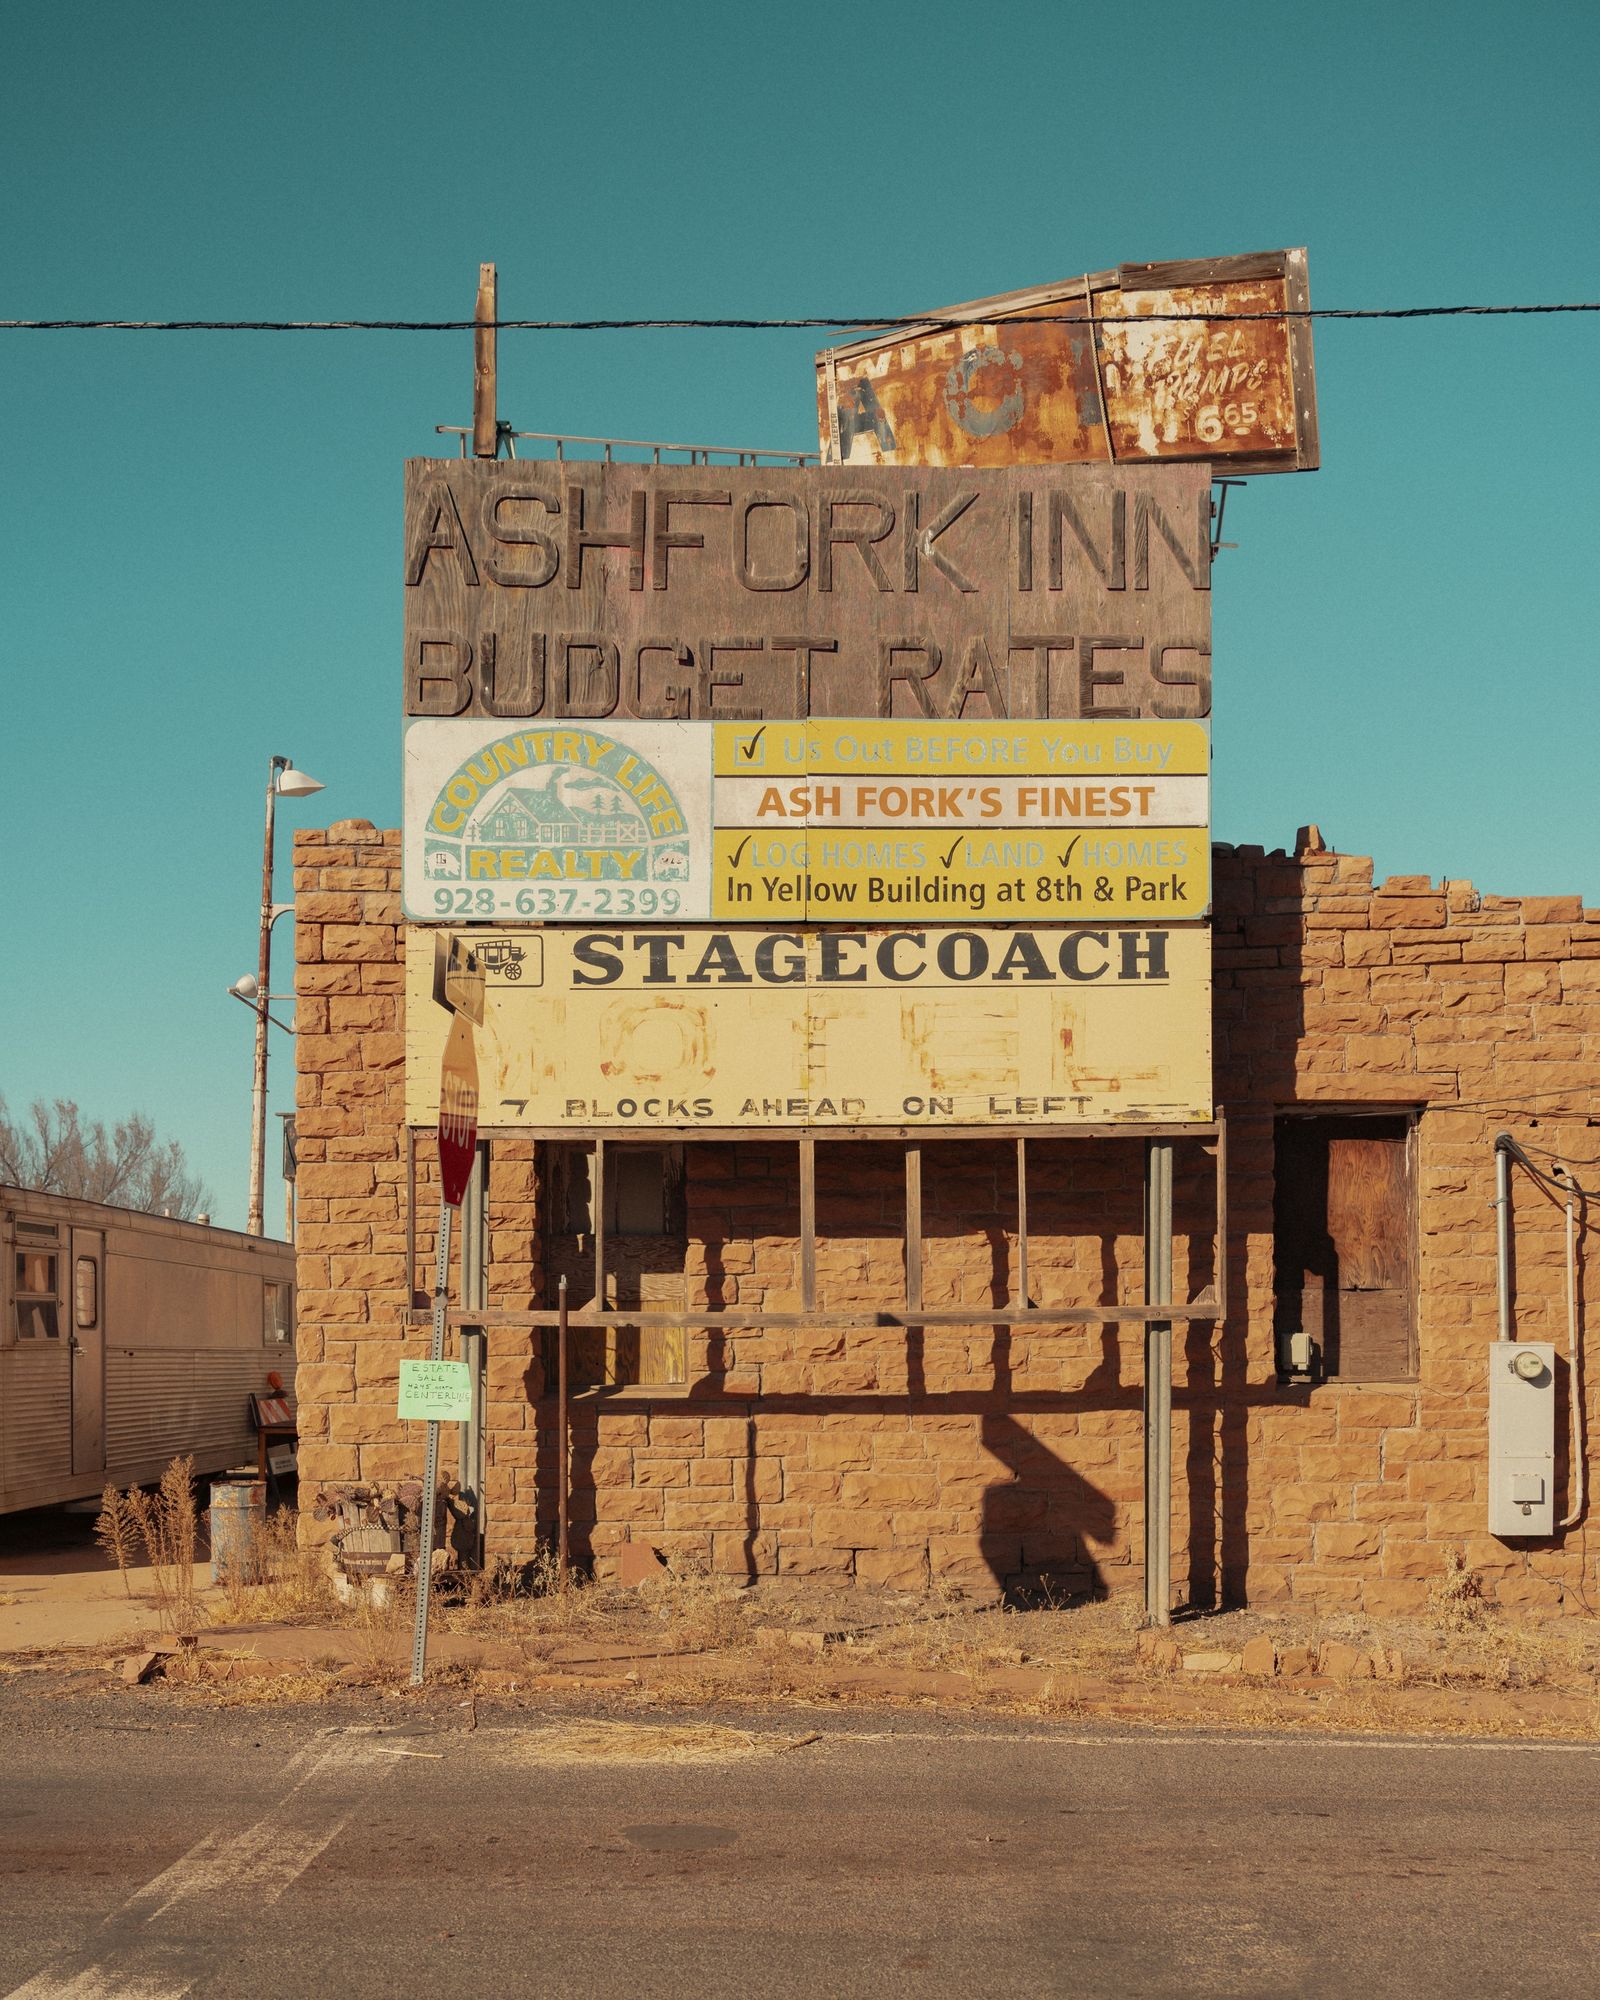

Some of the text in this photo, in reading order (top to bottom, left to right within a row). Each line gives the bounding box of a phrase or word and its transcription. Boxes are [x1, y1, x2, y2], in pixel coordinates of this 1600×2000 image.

[1147, 329, 1248, 371] FUEL
[1018, 488, 1212, 592] INN
[407, 630, 1212, 721] BUDGET RATES
[784, 734, 1174, 769] Us Out BEFORE You Buy
[433, 731, 685, 836] COUNTRY LIFE
[756, 784, 1156, 819] ASH FORK'S FINEST
[468, 849, 643, 880] REALTY
[751, 840, 1189, 869] LOG HOMES LAND HOMES
[433, 887, 682, 916] 928-637-2399
[727, 874, 1188, 910] In Yellow Building at 8th & Park
[572, 930, 1170, 985] STAGECOACH
[442, 1070, 479, 1150] STOP
[500, 1099, 530, 1118] 7
[565, 1098, 715, 1118] BLOCKS
[738, 1097, 866, 1117] AHEAD
[902, 1096, 955, 1116] ON
[412, 1362, 459, 1374] ESTATE
[417, 1374, 445, 1382] SALE
